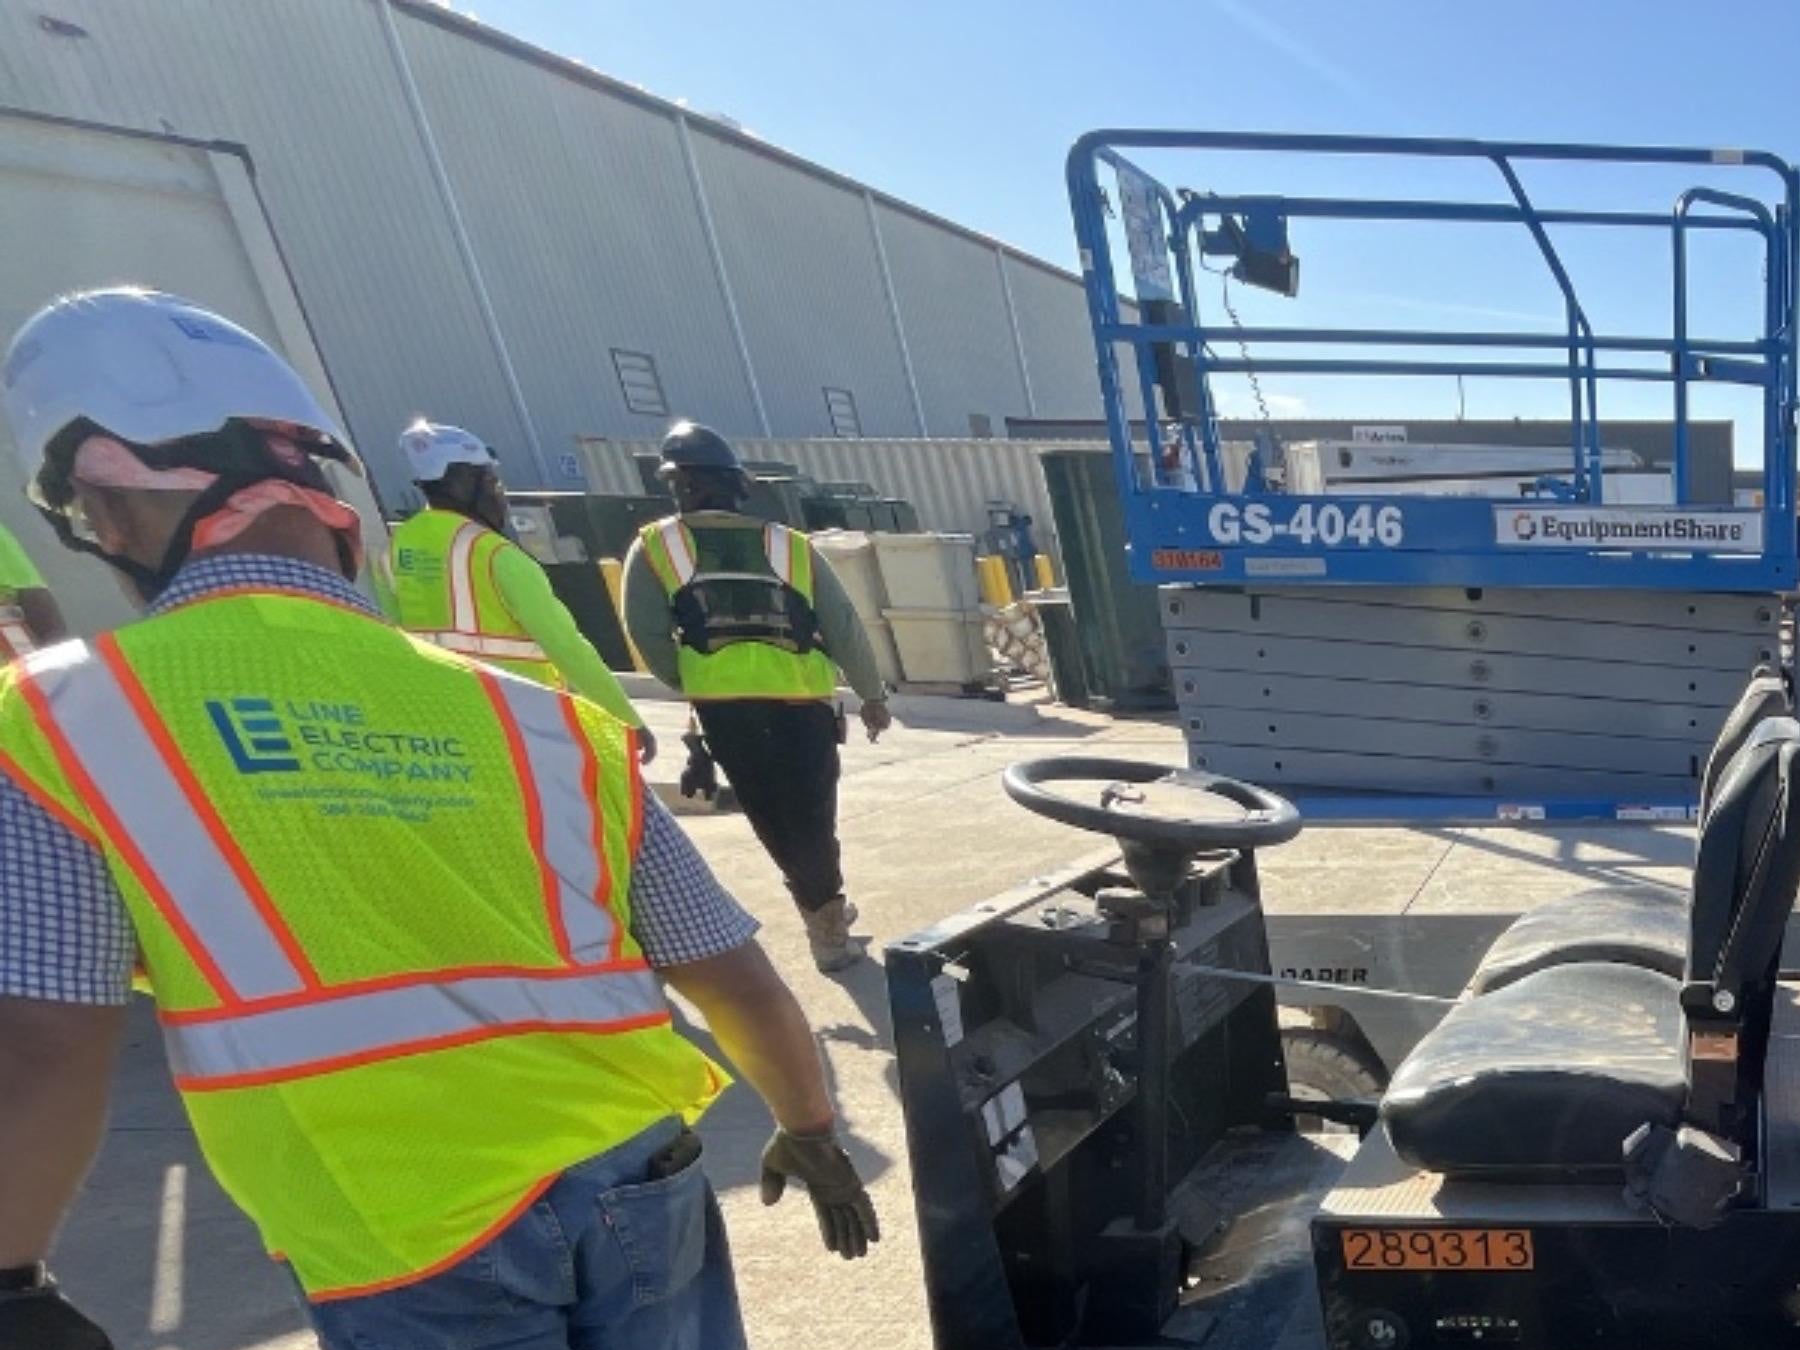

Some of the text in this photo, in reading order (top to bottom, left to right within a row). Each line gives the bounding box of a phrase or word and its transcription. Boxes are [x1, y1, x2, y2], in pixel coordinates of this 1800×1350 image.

[1207, 503, 1403, 547] GS-4046
[1541, 514, 1743, 541] EquipmentShare
[288, 702, 363, 726] LINE
[301, 727, 463, 757] ELECTRIC
[312, 753, 473, 784] COMPANY
[1349, 1232, 1529, 1267] 289313
